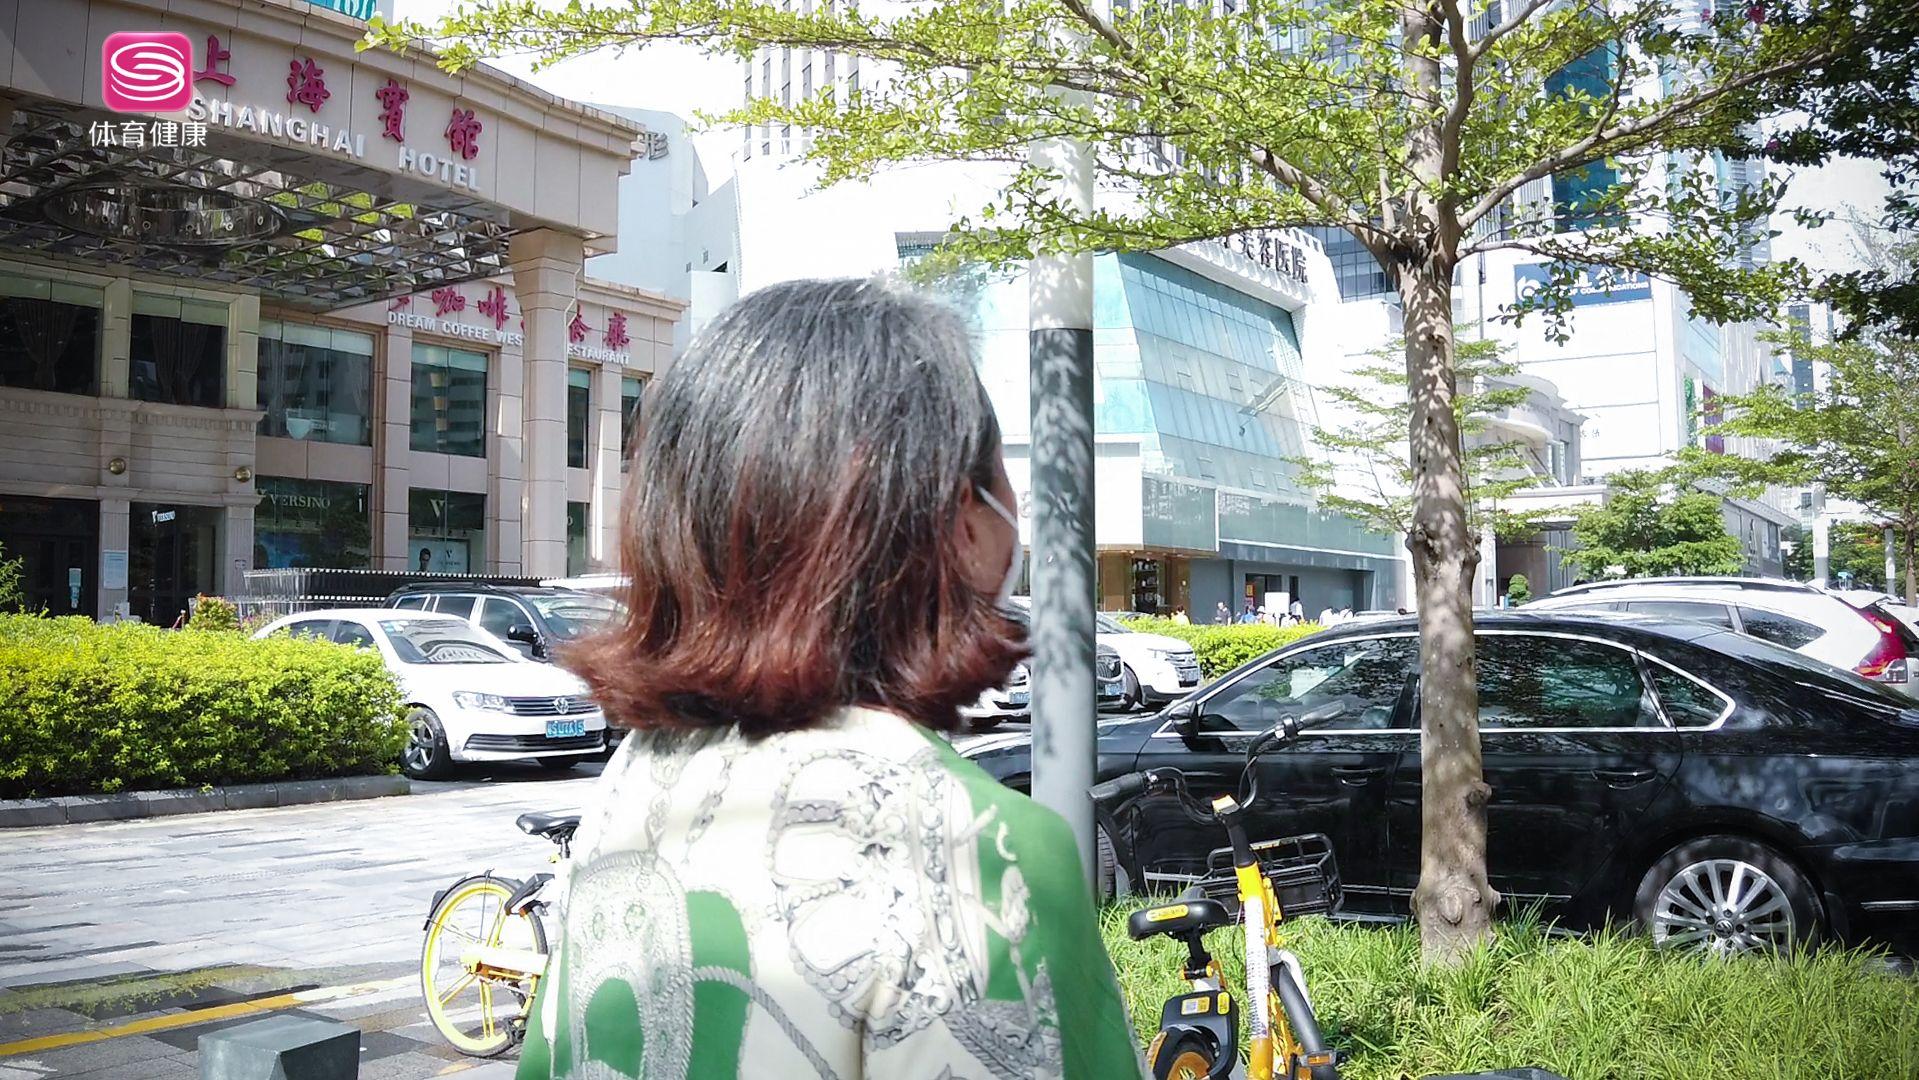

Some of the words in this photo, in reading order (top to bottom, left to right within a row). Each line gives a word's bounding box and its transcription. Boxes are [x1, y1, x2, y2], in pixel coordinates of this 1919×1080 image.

[185, 96, 366, 159] SHANGHAI
[399, 145, 480, 192] HOTEL
[388, 311, 436, 331] DREAM
[442, 322, 490, 341] COFFEE
[495, 329, 523, 346] WES
[567, 345, 630, 365] ESTAURANT
[270, 493, 332, 510] VERSINO
